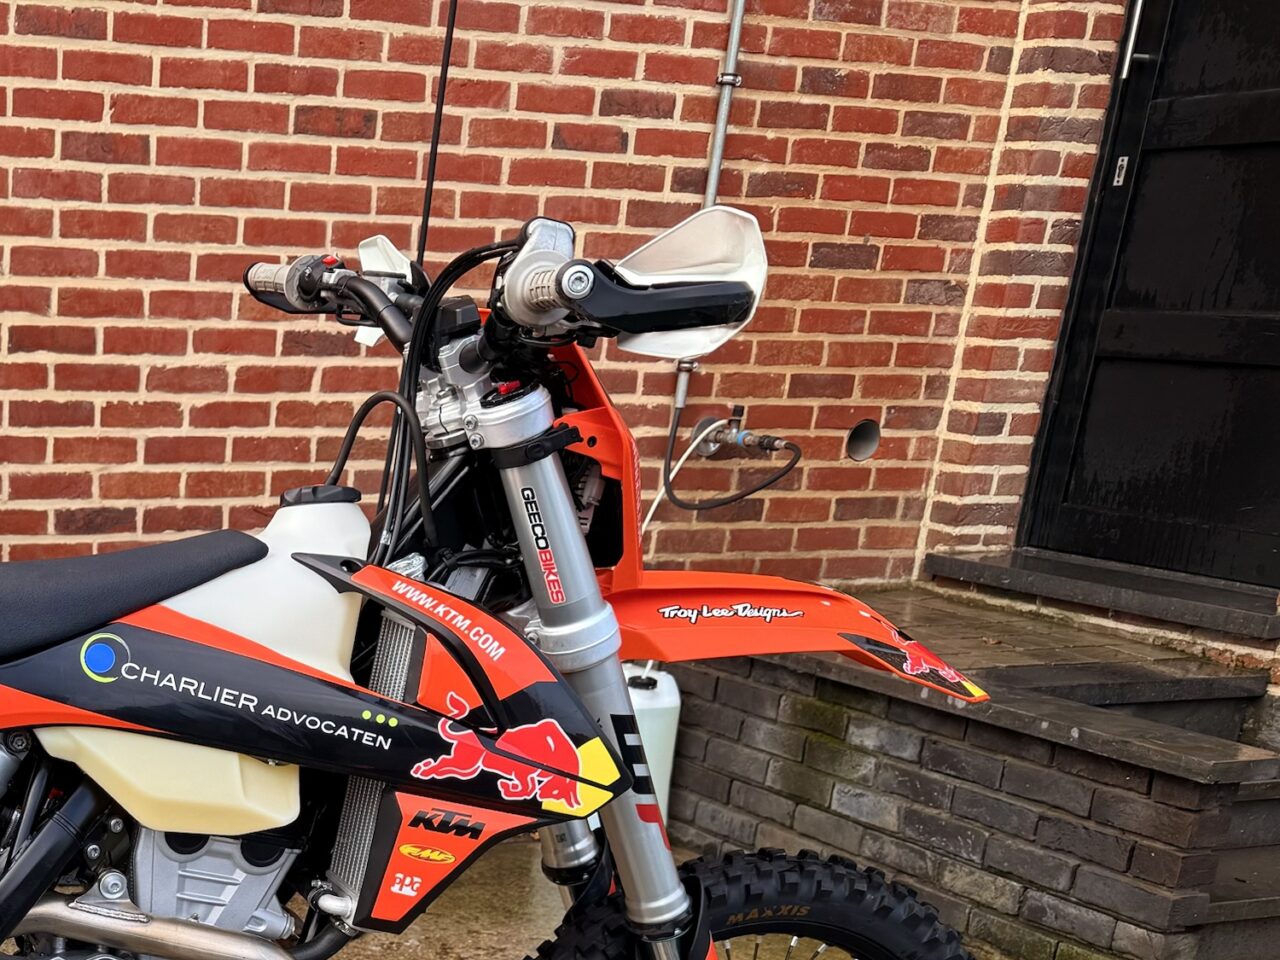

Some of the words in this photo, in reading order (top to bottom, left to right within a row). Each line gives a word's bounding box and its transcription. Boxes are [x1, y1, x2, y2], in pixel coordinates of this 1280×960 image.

[520, 486, 567, 605] GEECOBIKES
[391, 580, 507, 662] WWW.KTM.COM
[658, 604, 698, 625] Troy
[701, 604, 735, 618] Lee
[730, 602, 805, 624] Designs
[120, 661, 259, 714] CHARLIER
[260, 704, 393, 751] ADVOCATEN
[407, 807, 487, 840] KTM
[726, 905, 811, 926] MAXXIS
